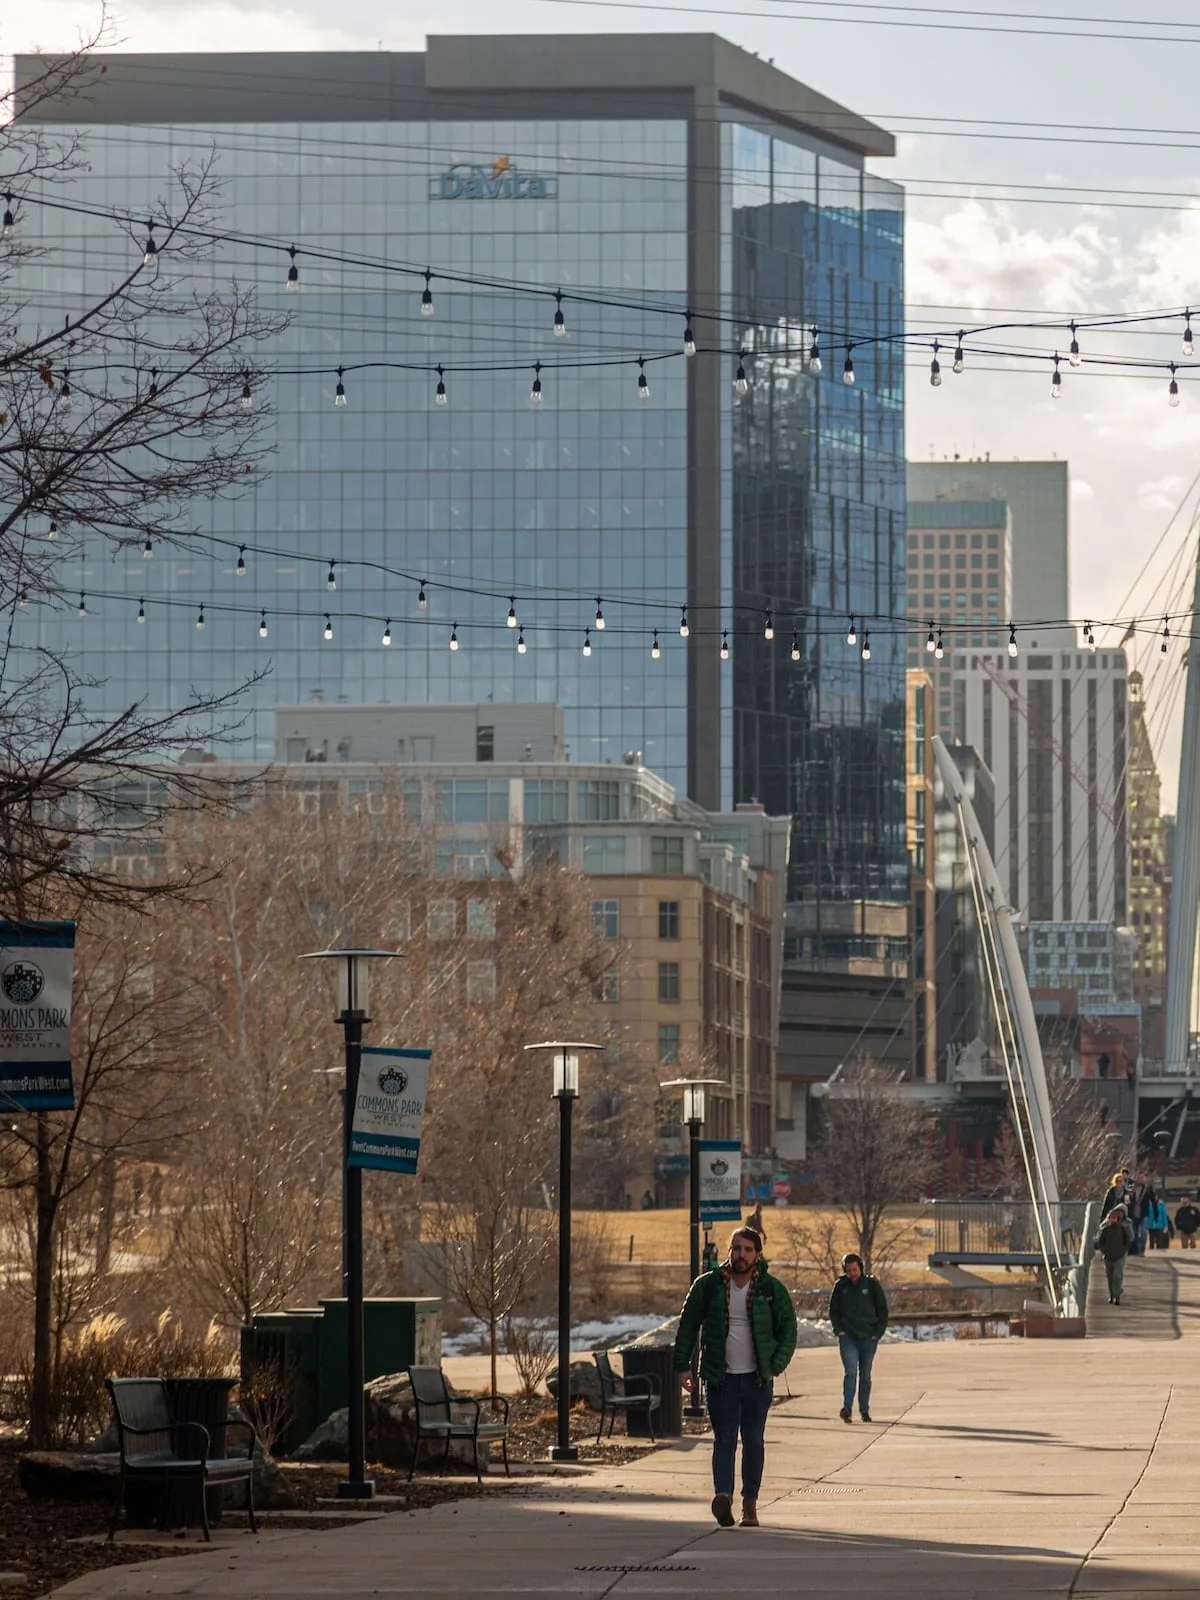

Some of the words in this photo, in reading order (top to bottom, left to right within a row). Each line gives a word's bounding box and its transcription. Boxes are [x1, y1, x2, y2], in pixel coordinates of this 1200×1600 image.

[440, 165, 547, 199] DaVita
[38, 1007, 67, 1029] PARK
[1, 1032, 43, 1041] WEST
[0, 1076, 70, 1091] mmonsParkWest.com
[357, 1095, 399, 1113] COMMONS
[401, 1099, 423, 1116] PARK
[374, 1113, 404, 1122] WEST
